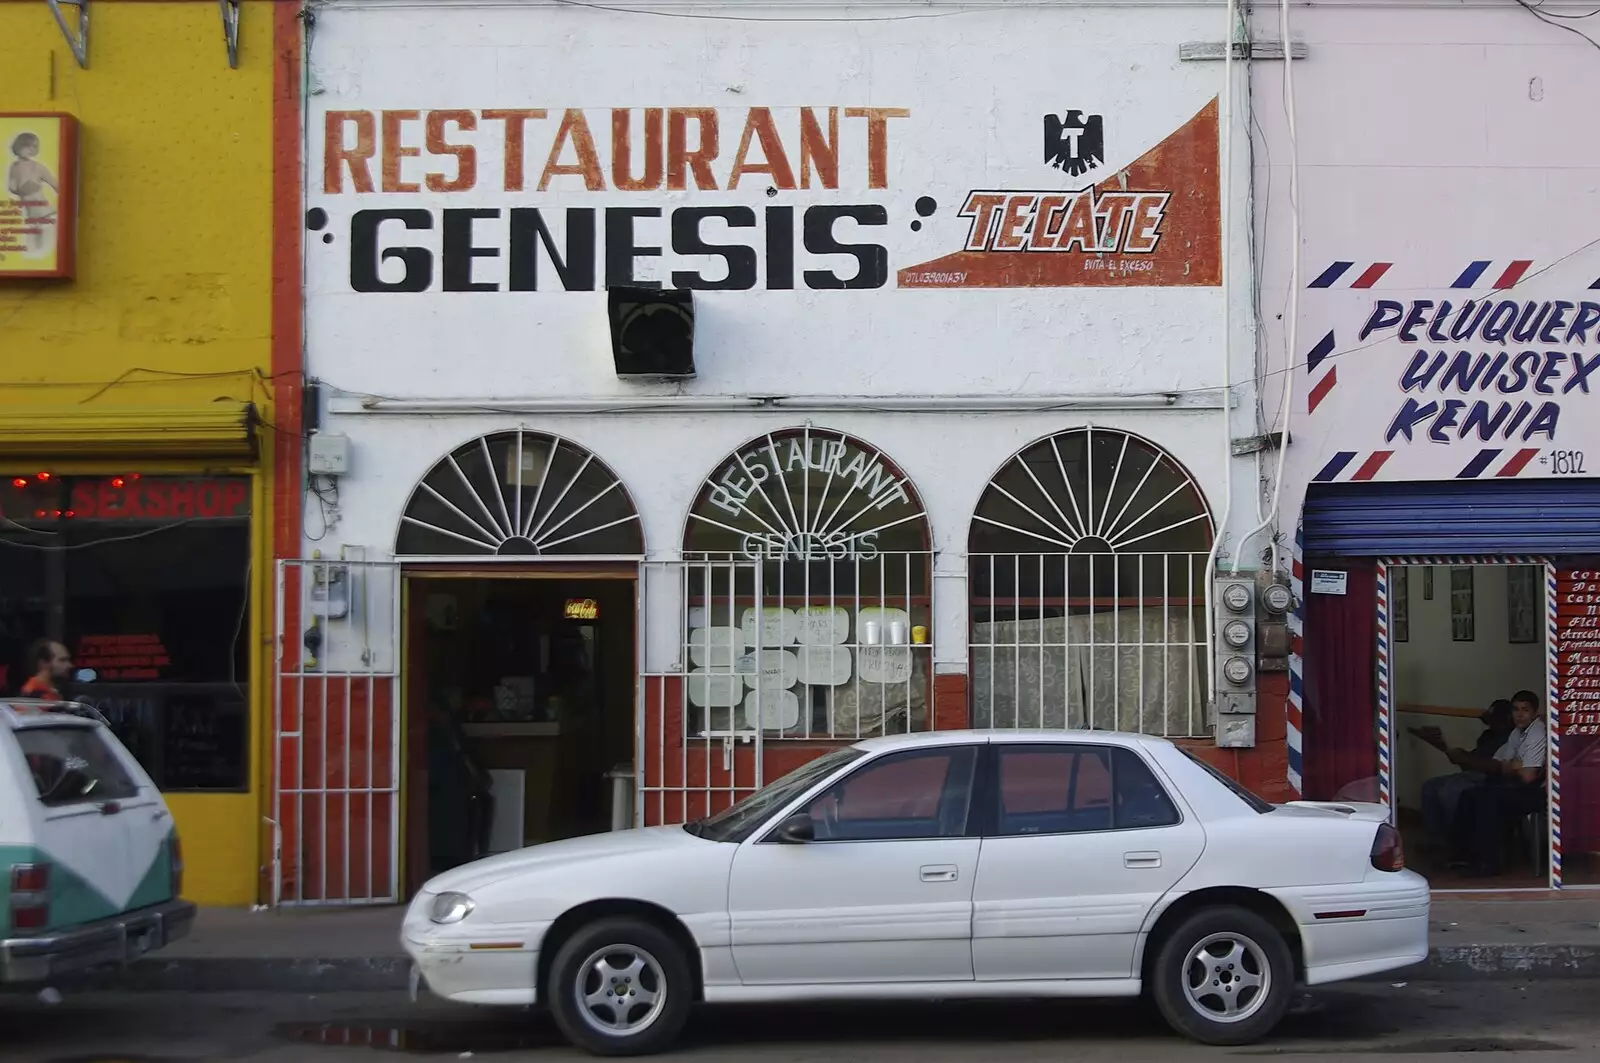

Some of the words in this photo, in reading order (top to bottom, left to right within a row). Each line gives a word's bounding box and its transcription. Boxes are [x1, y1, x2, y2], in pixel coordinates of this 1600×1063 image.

[324, 106, 910, 194] RESTAURANT
[957, 184, 1172, 253] TECATE
[350, 204, 888, 293] GENESIS
[1084, 259, 1105, 270] EVITA
[1108, 259, 1117, 270] EL
[1120, 260, 1154, 271] EXCESO
[1358, 299, 1600, 346] PELUQUER
[1398, 349, 1600, 395] UNISEX
[1384, 397, 1560, 444] KENIA
[709, 437, 910, 518] RESTAURANT
[742, 531, 880, 561] GENESIS
